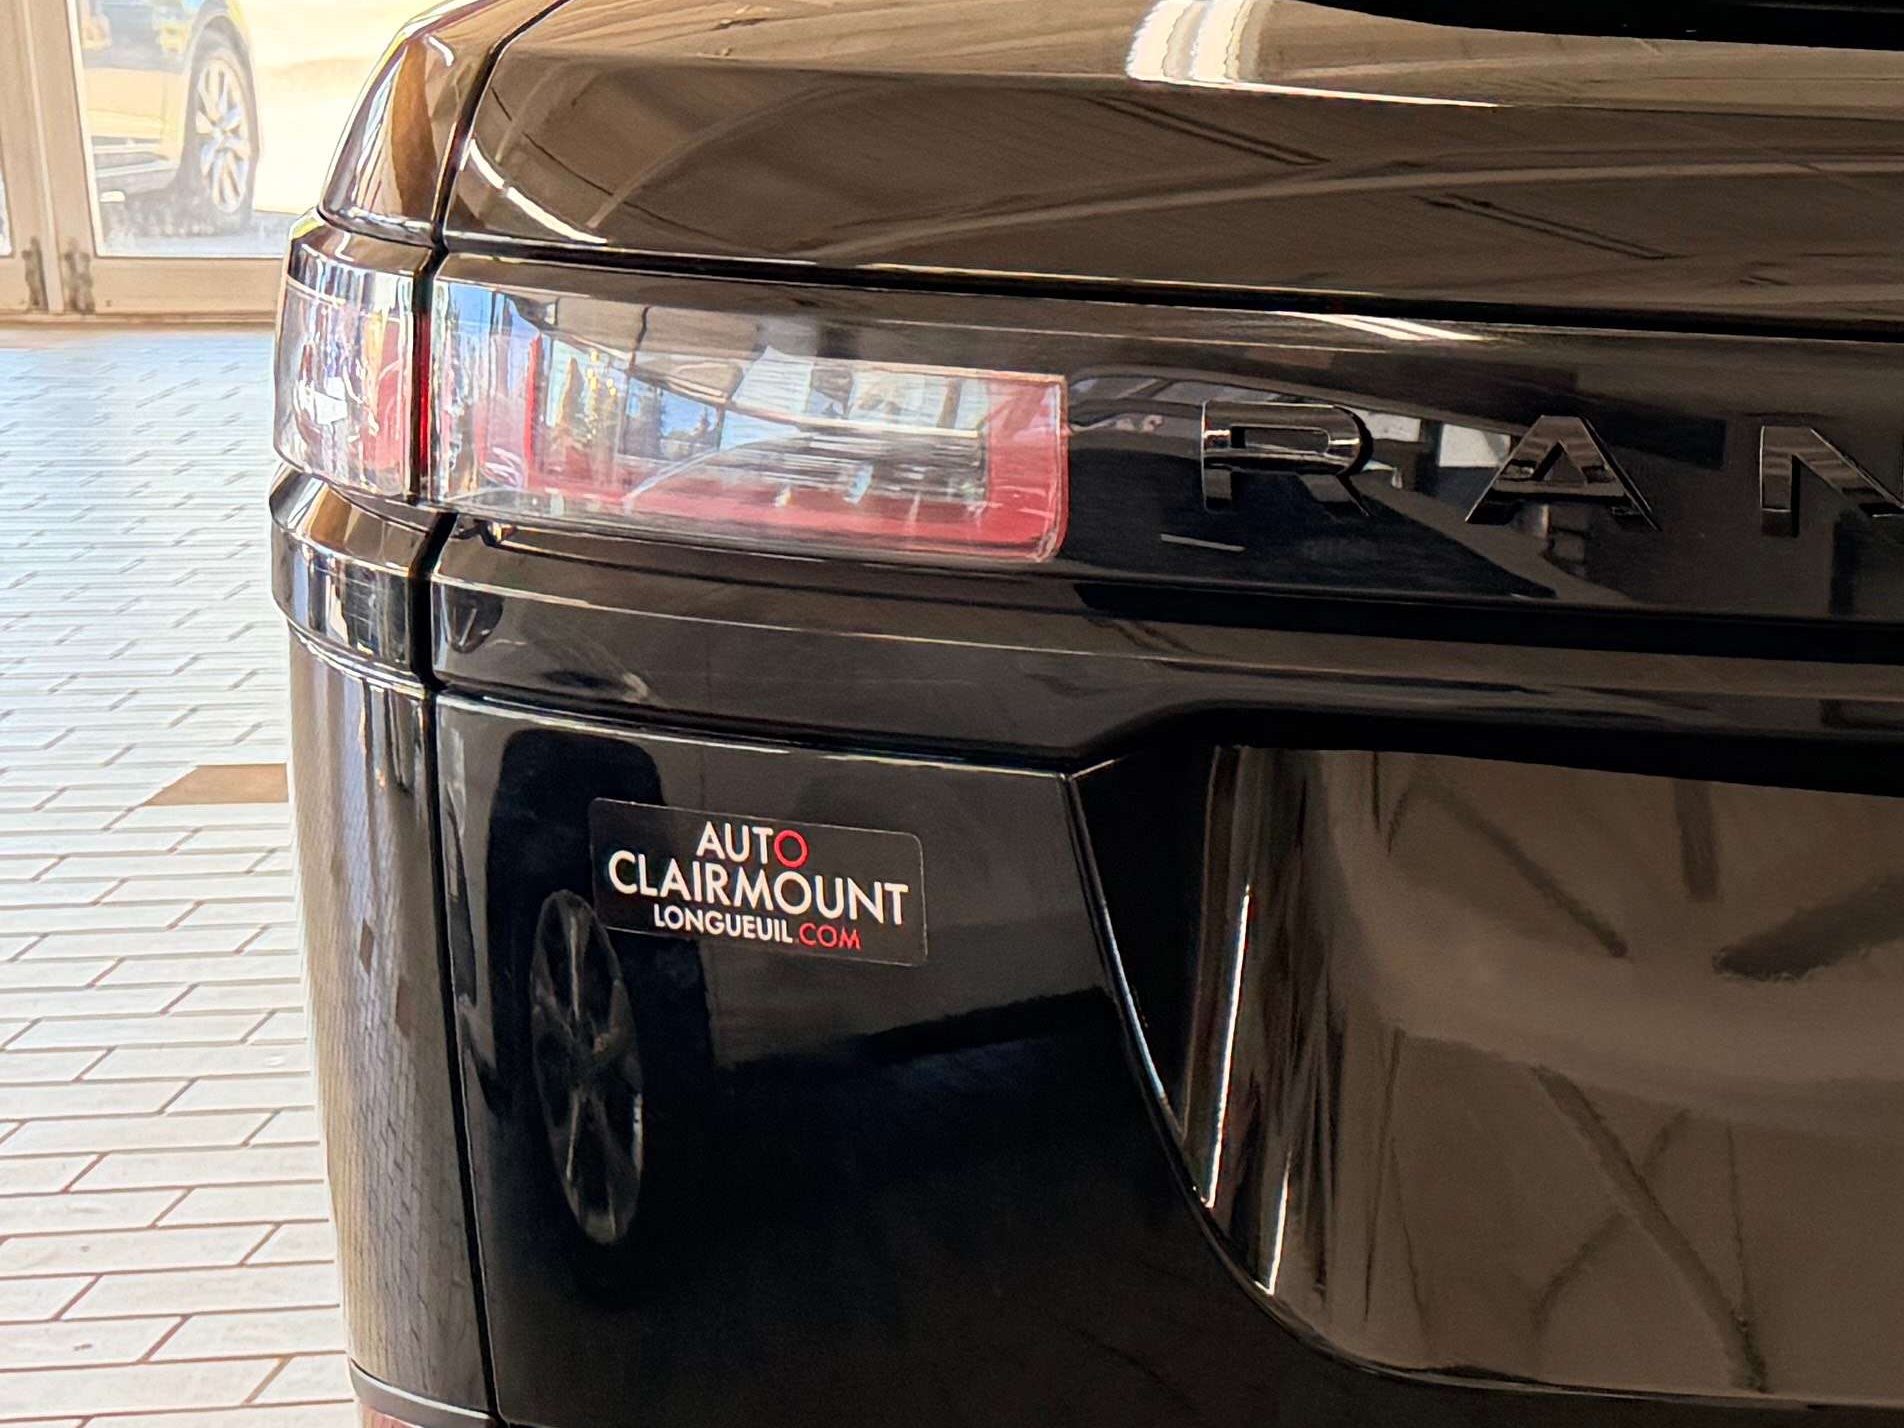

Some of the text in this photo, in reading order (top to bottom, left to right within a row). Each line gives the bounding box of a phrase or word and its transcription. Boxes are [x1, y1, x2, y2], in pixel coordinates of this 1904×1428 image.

[695, 820, 809, 869] AUTO
[607, 849, 909, 926] CLAIRMOUNT
[653, 903, 862, 951] LONGUEUIL.COM
